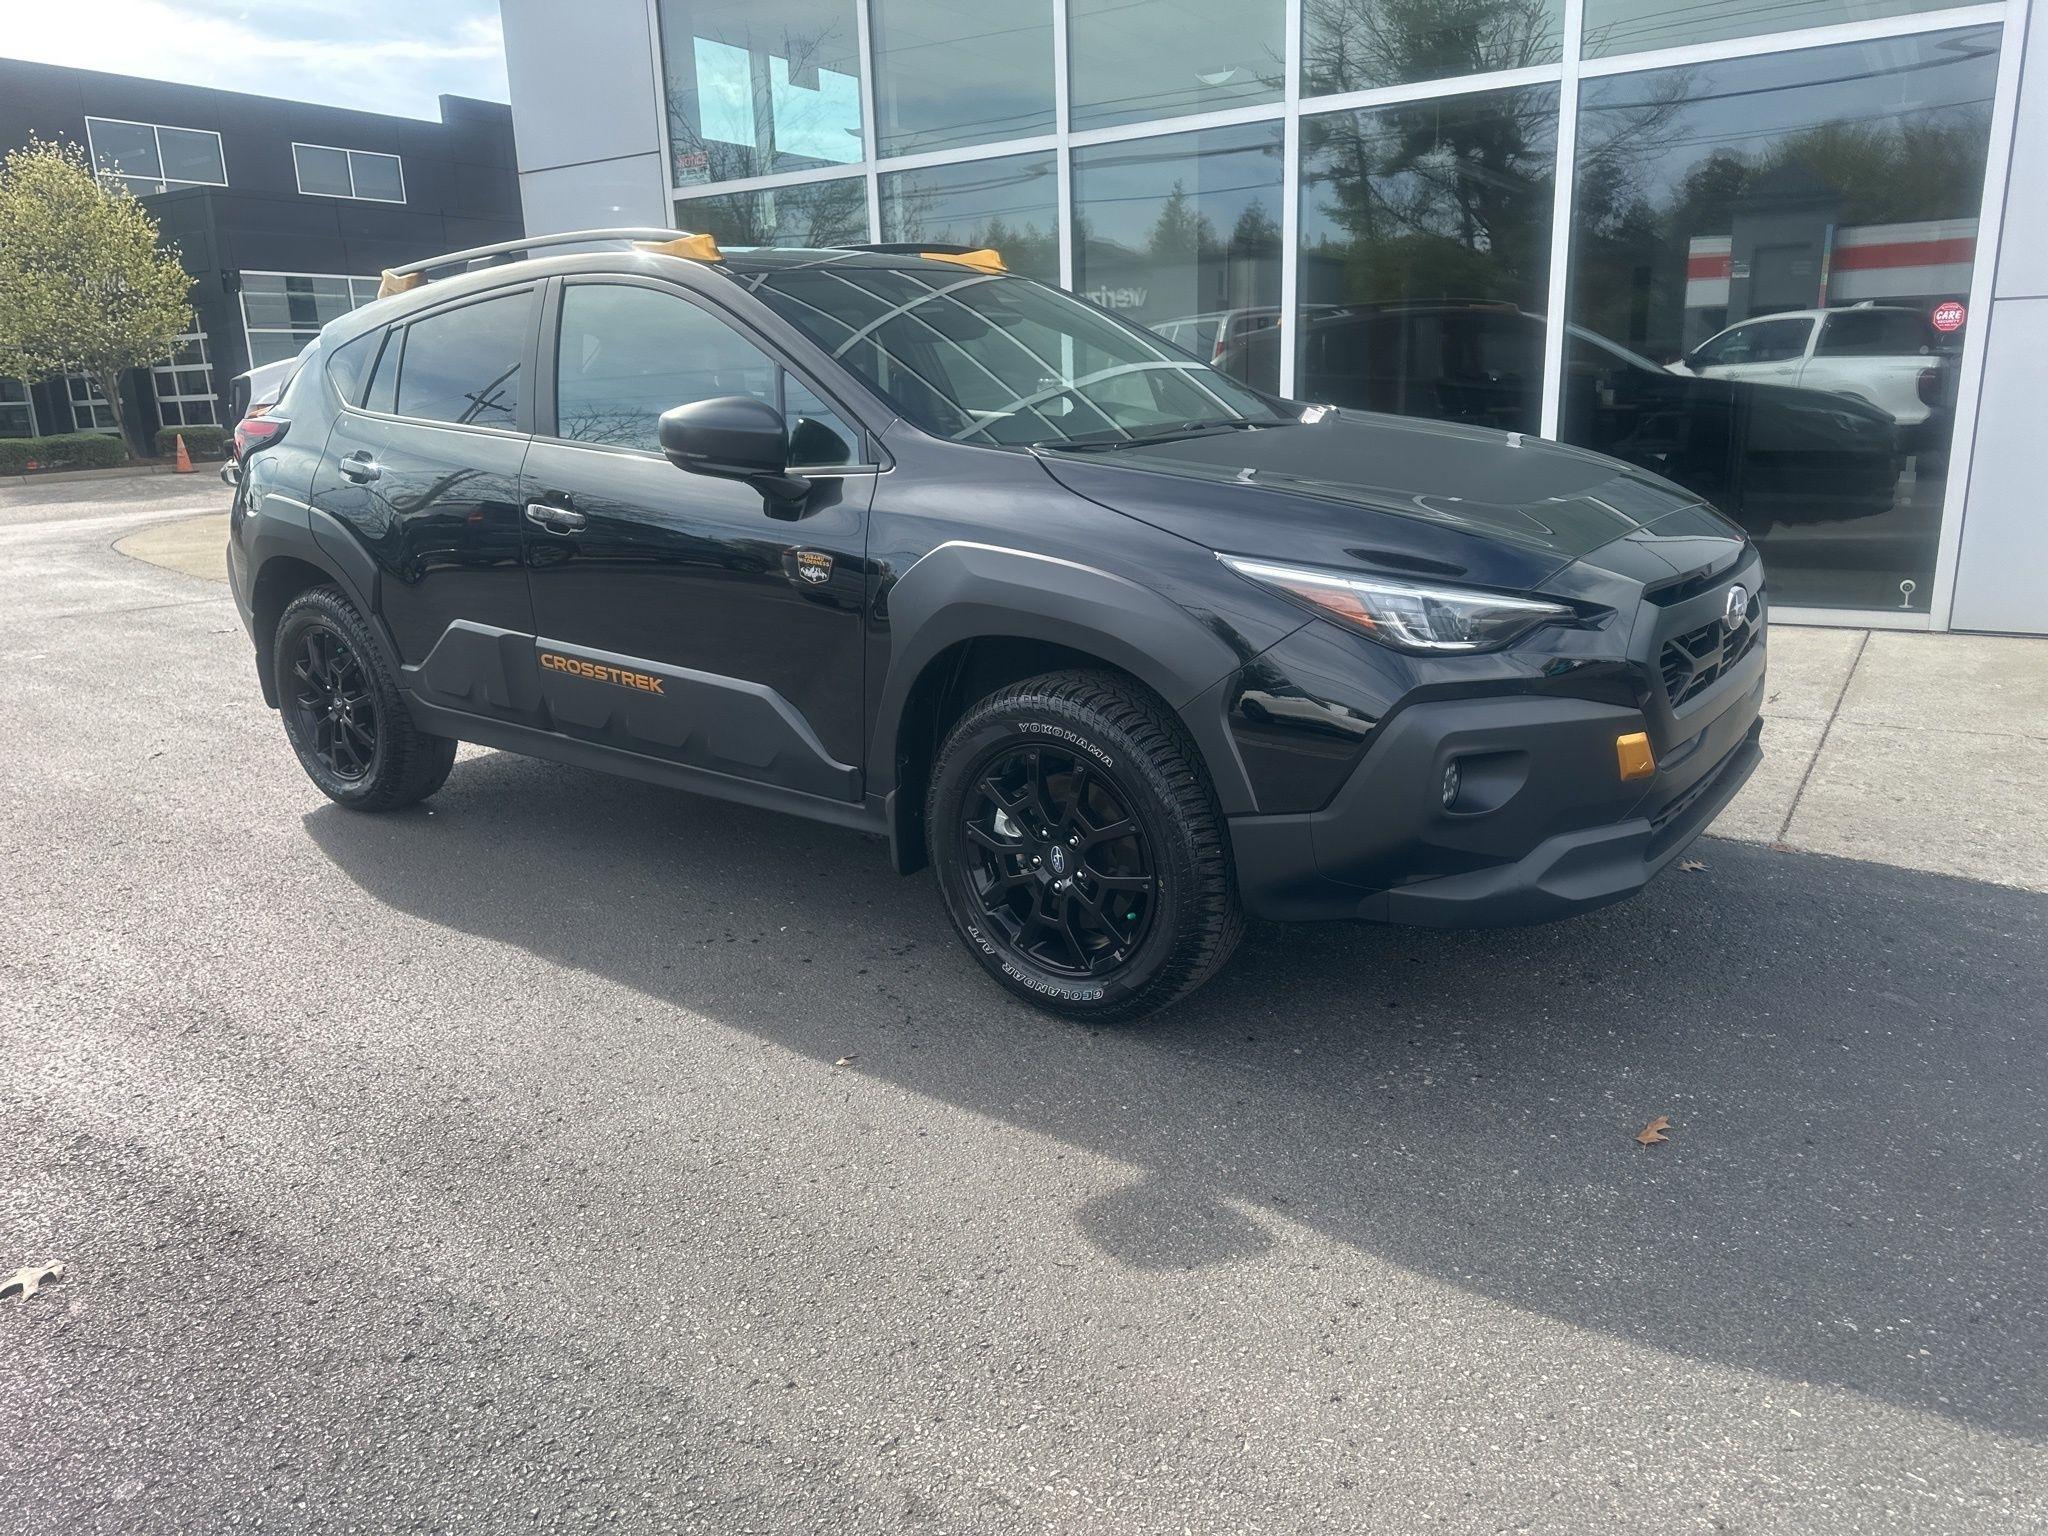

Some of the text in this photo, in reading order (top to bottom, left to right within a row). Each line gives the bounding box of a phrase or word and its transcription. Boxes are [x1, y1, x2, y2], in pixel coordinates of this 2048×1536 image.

[1936, 310, 1962, 320] CARE
[541, 653, 664, 694] CROSSTREK
[1018, 722, 1113, 768] YOKOHAMA
[1001, 961, 1104, 1001] GEOLANDAR
